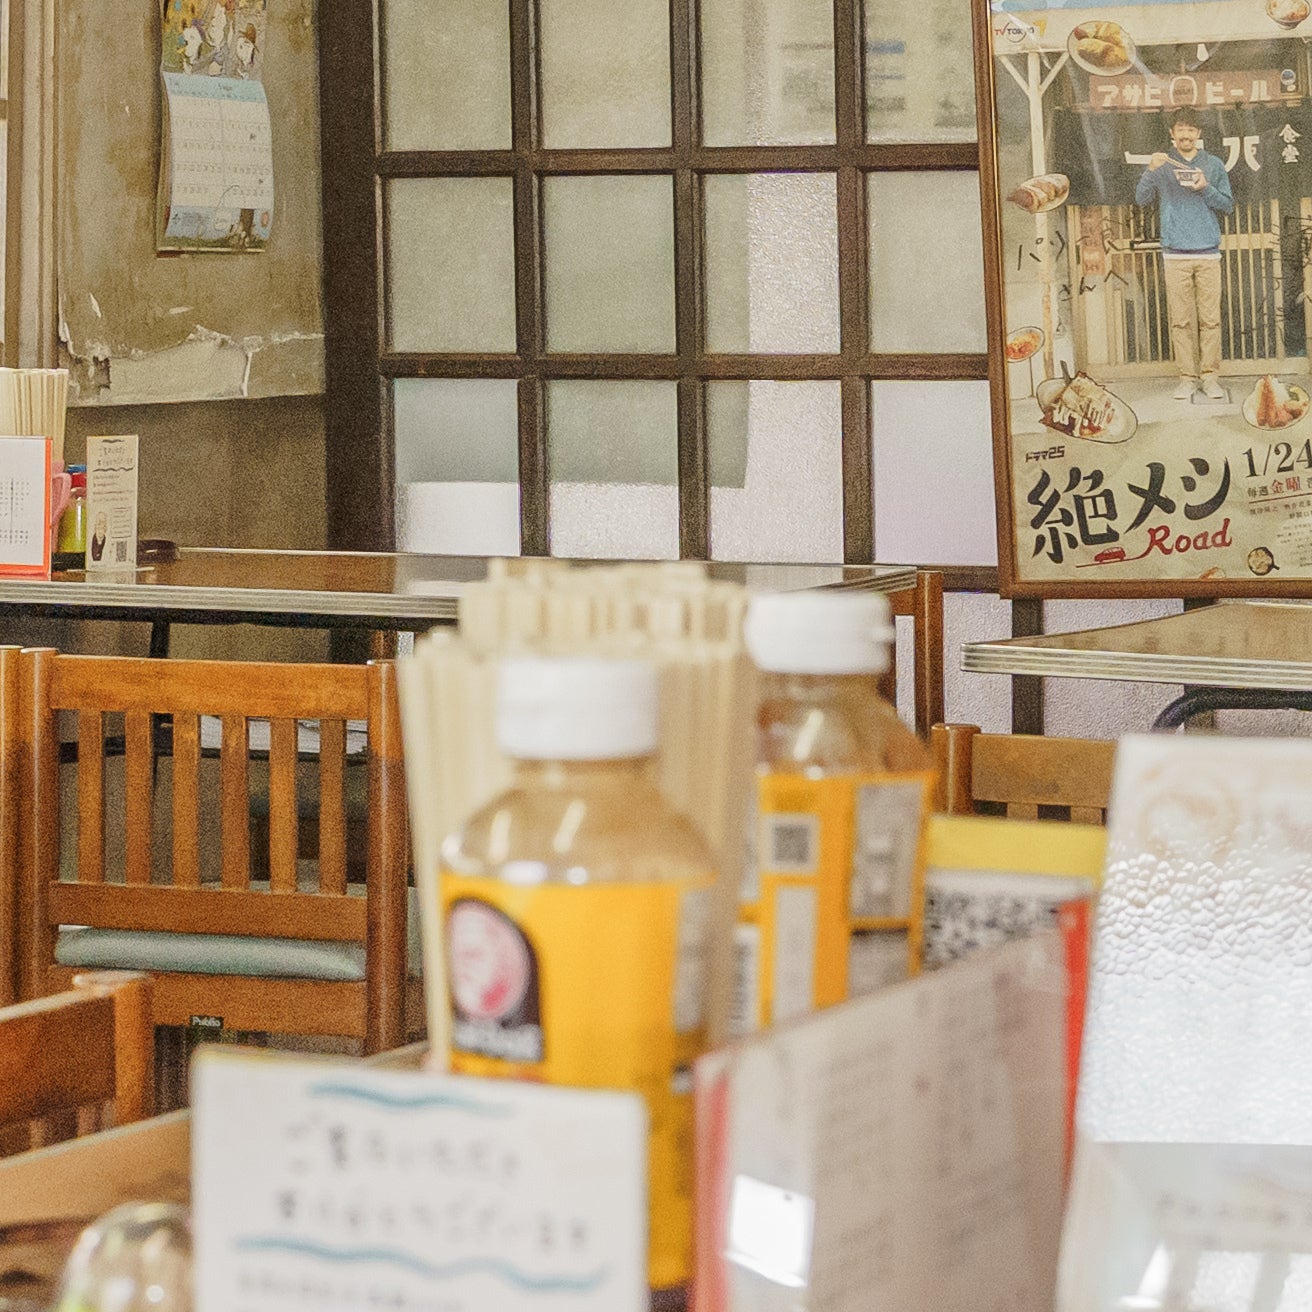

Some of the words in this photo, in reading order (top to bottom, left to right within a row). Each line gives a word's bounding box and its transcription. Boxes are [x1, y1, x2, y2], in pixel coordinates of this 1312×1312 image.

[1097, 84, 1163, 108] アサヒ
[1206, 80, 1271, 105] ビール
[1027, 456, 1232, 564] 絶メシ
[1145, 518, 1234, 556] Road
